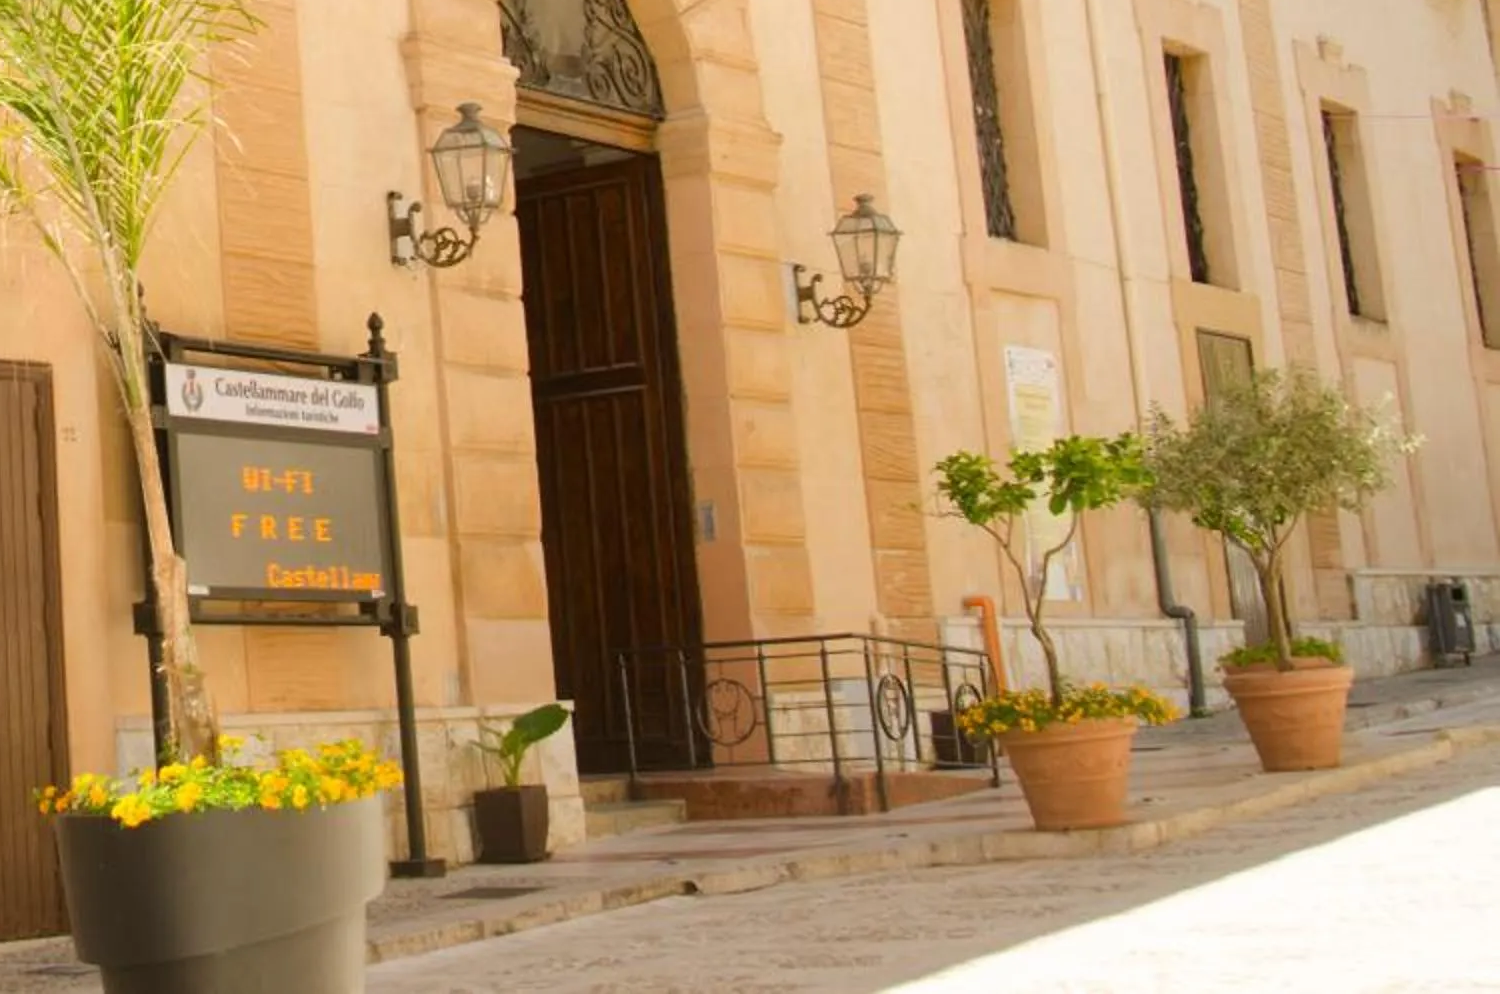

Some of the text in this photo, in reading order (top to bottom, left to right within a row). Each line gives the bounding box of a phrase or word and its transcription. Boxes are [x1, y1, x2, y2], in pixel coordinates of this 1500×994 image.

[215, 377, 365, 411] Castellammare del Golfo
